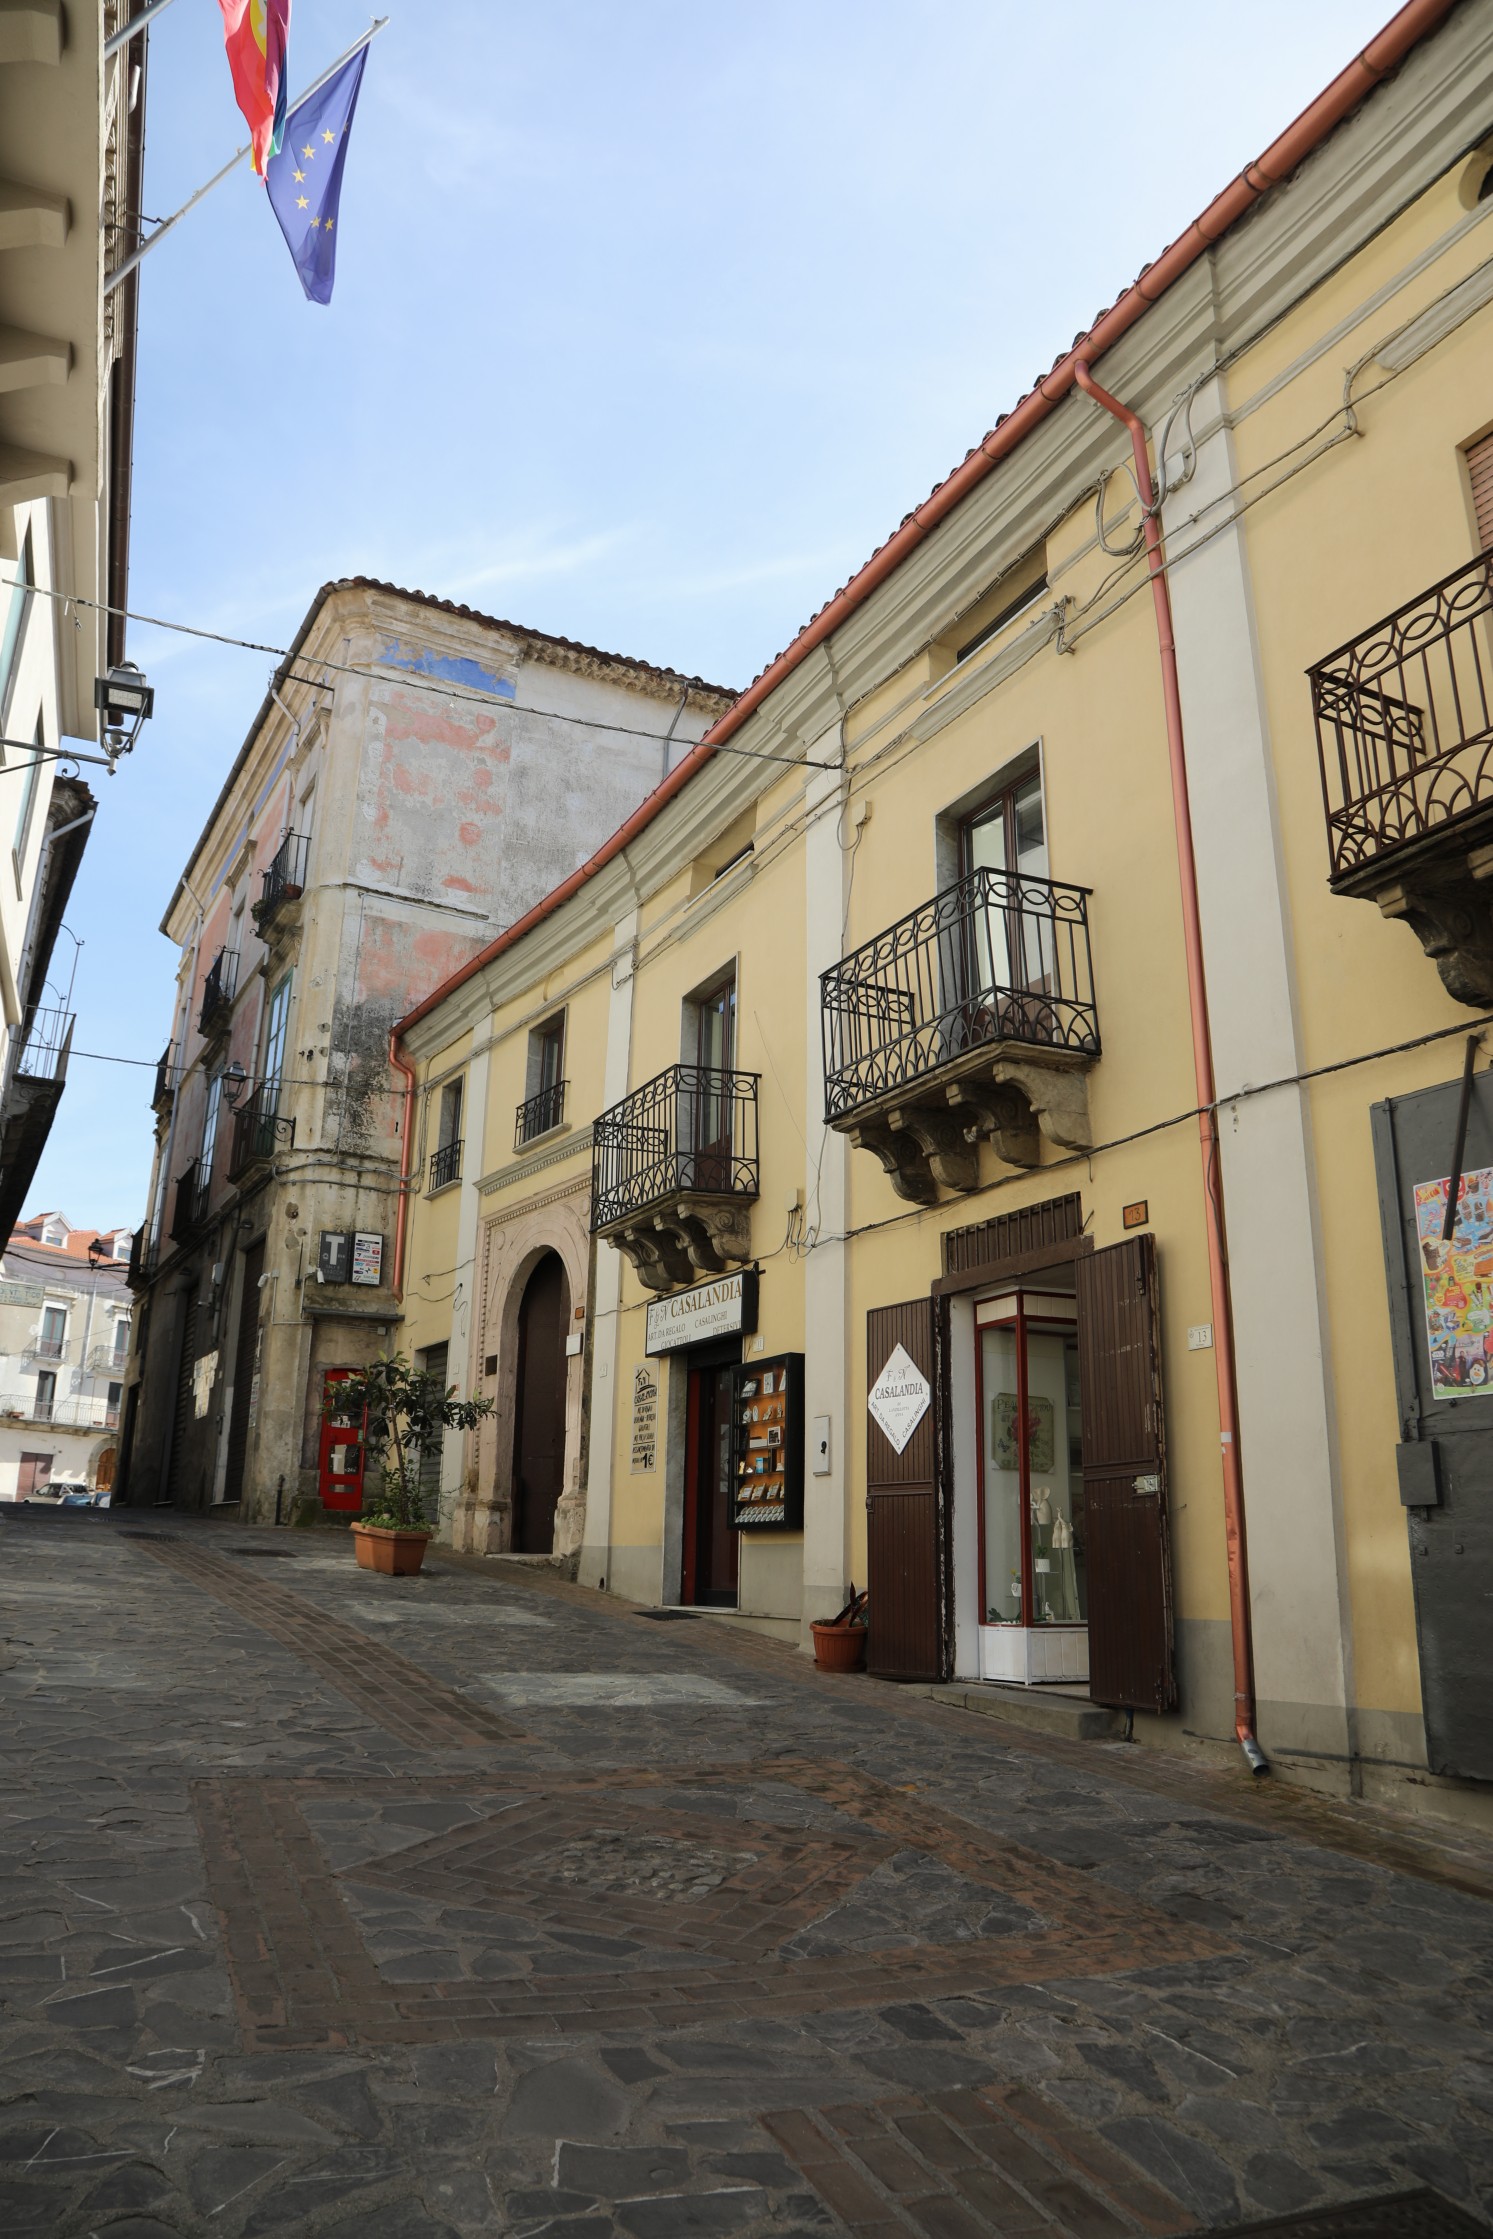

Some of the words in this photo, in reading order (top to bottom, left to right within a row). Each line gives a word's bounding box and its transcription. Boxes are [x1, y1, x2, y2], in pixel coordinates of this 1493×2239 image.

[1129, 1208, 1141, 1221] 13
[325, 1234, 345, 1265] T
[671, 1278, 742, 1318] CASALANDIA
[694, 1310, 728, 1329] CASALINGHI
[666, 1323, 686, 1337] REGALO
[1198, 1330, 1207, 1343] 13
[660, 1334, 691, 1350] GIOCATTOLI
[875, 1382, 924, 1400] CASALANDIA
[902, 1397, 926, 1438] CASALINGHI
[879, 1413, 886, 1423] DA
[884, 1421, 901, 1446] REGALO
